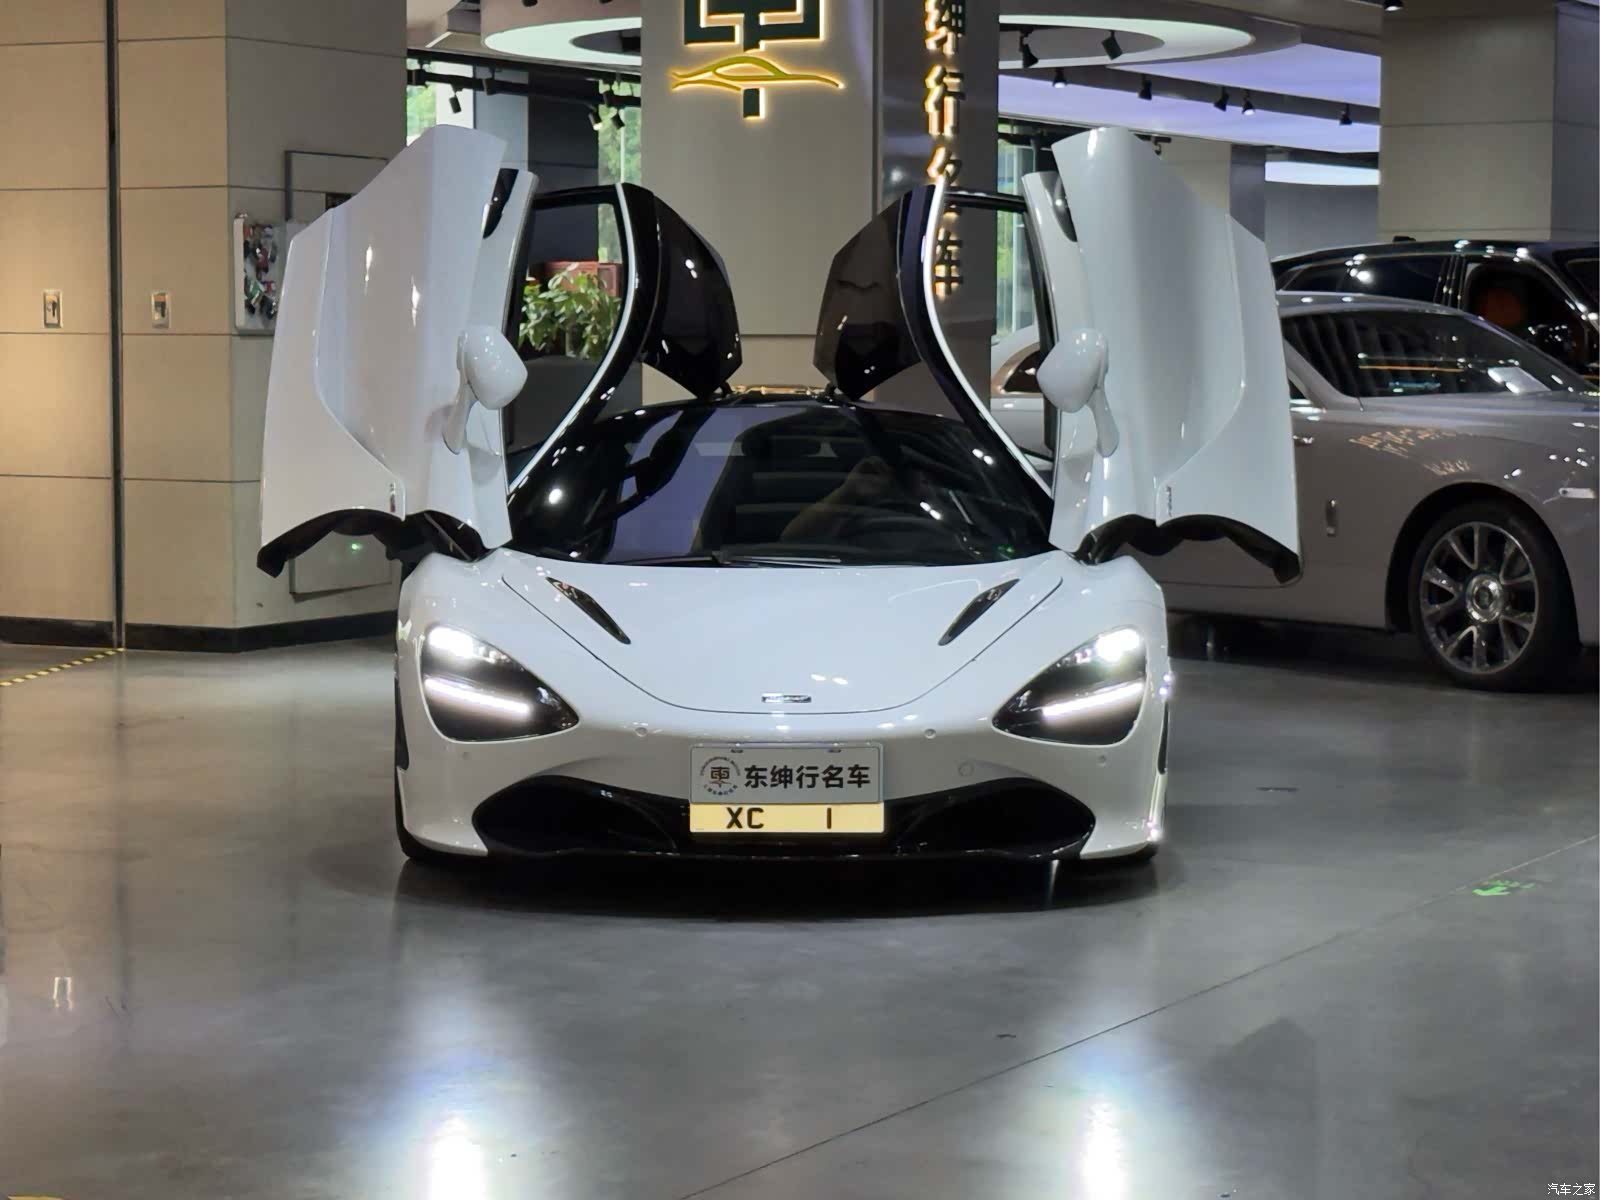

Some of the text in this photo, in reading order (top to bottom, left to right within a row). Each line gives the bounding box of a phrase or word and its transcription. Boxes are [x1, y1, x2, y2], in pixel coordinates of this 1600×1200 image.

[744, 764, 871, 789] 东绅行名车
[726, 807, 765, 829] XC
